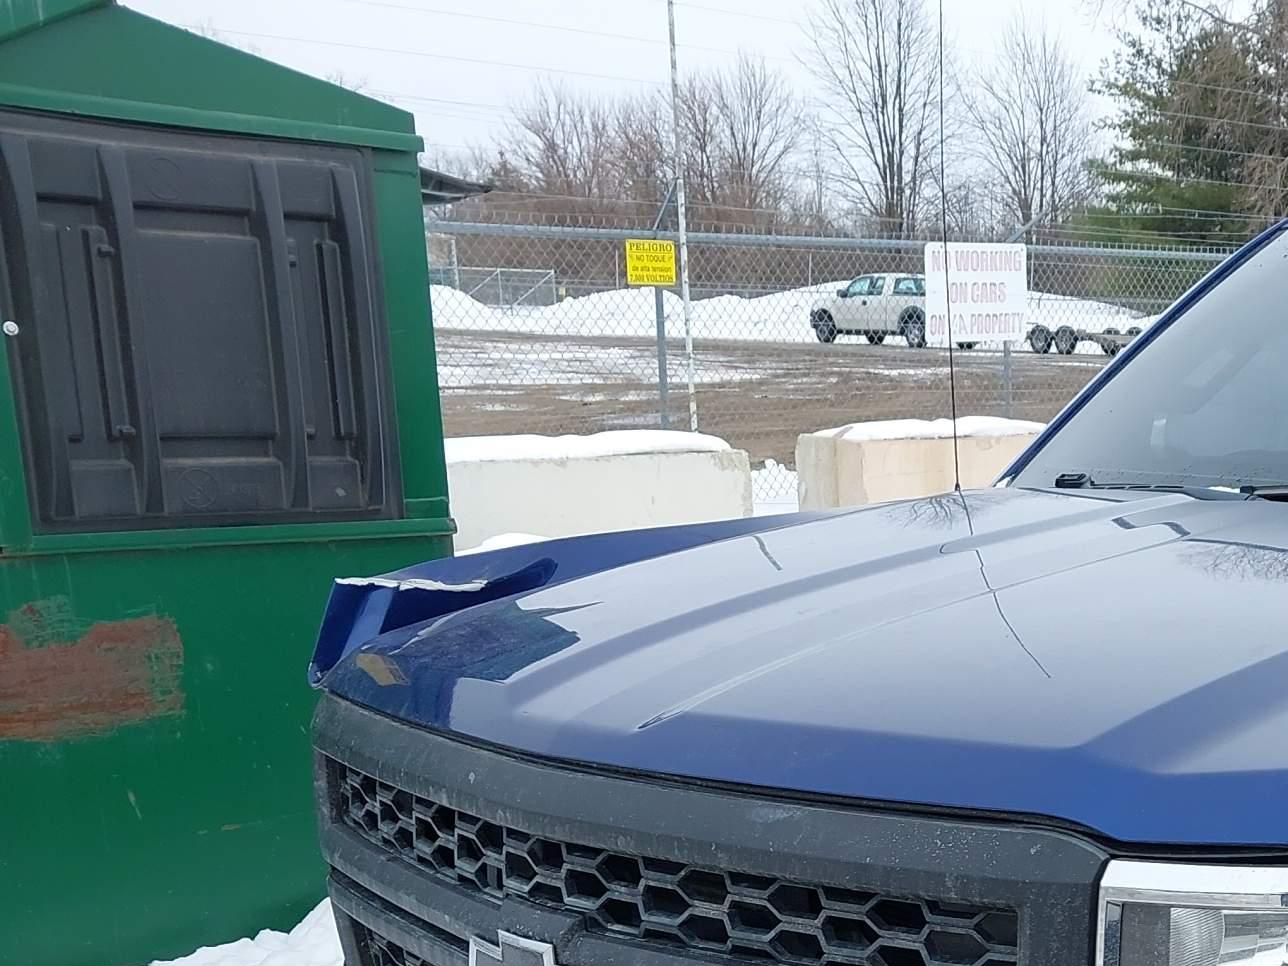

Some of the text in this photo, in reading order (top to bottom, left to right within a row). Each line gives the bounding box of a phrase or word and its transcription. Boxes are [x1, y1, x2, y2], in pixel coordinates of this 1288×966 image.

[629, 242, 673, 252] PELIGRO
[636, 254, 666, 263] NO TOQUE
[931, 249, 1022, 272] NO WORKING
[646, 274, 674, 283] VOLTIOS
[950, 281, 1006, 304] ON CARS
[930, 314, 946, 336] ON
[971, 312, 1024, 335] PROPERTY
